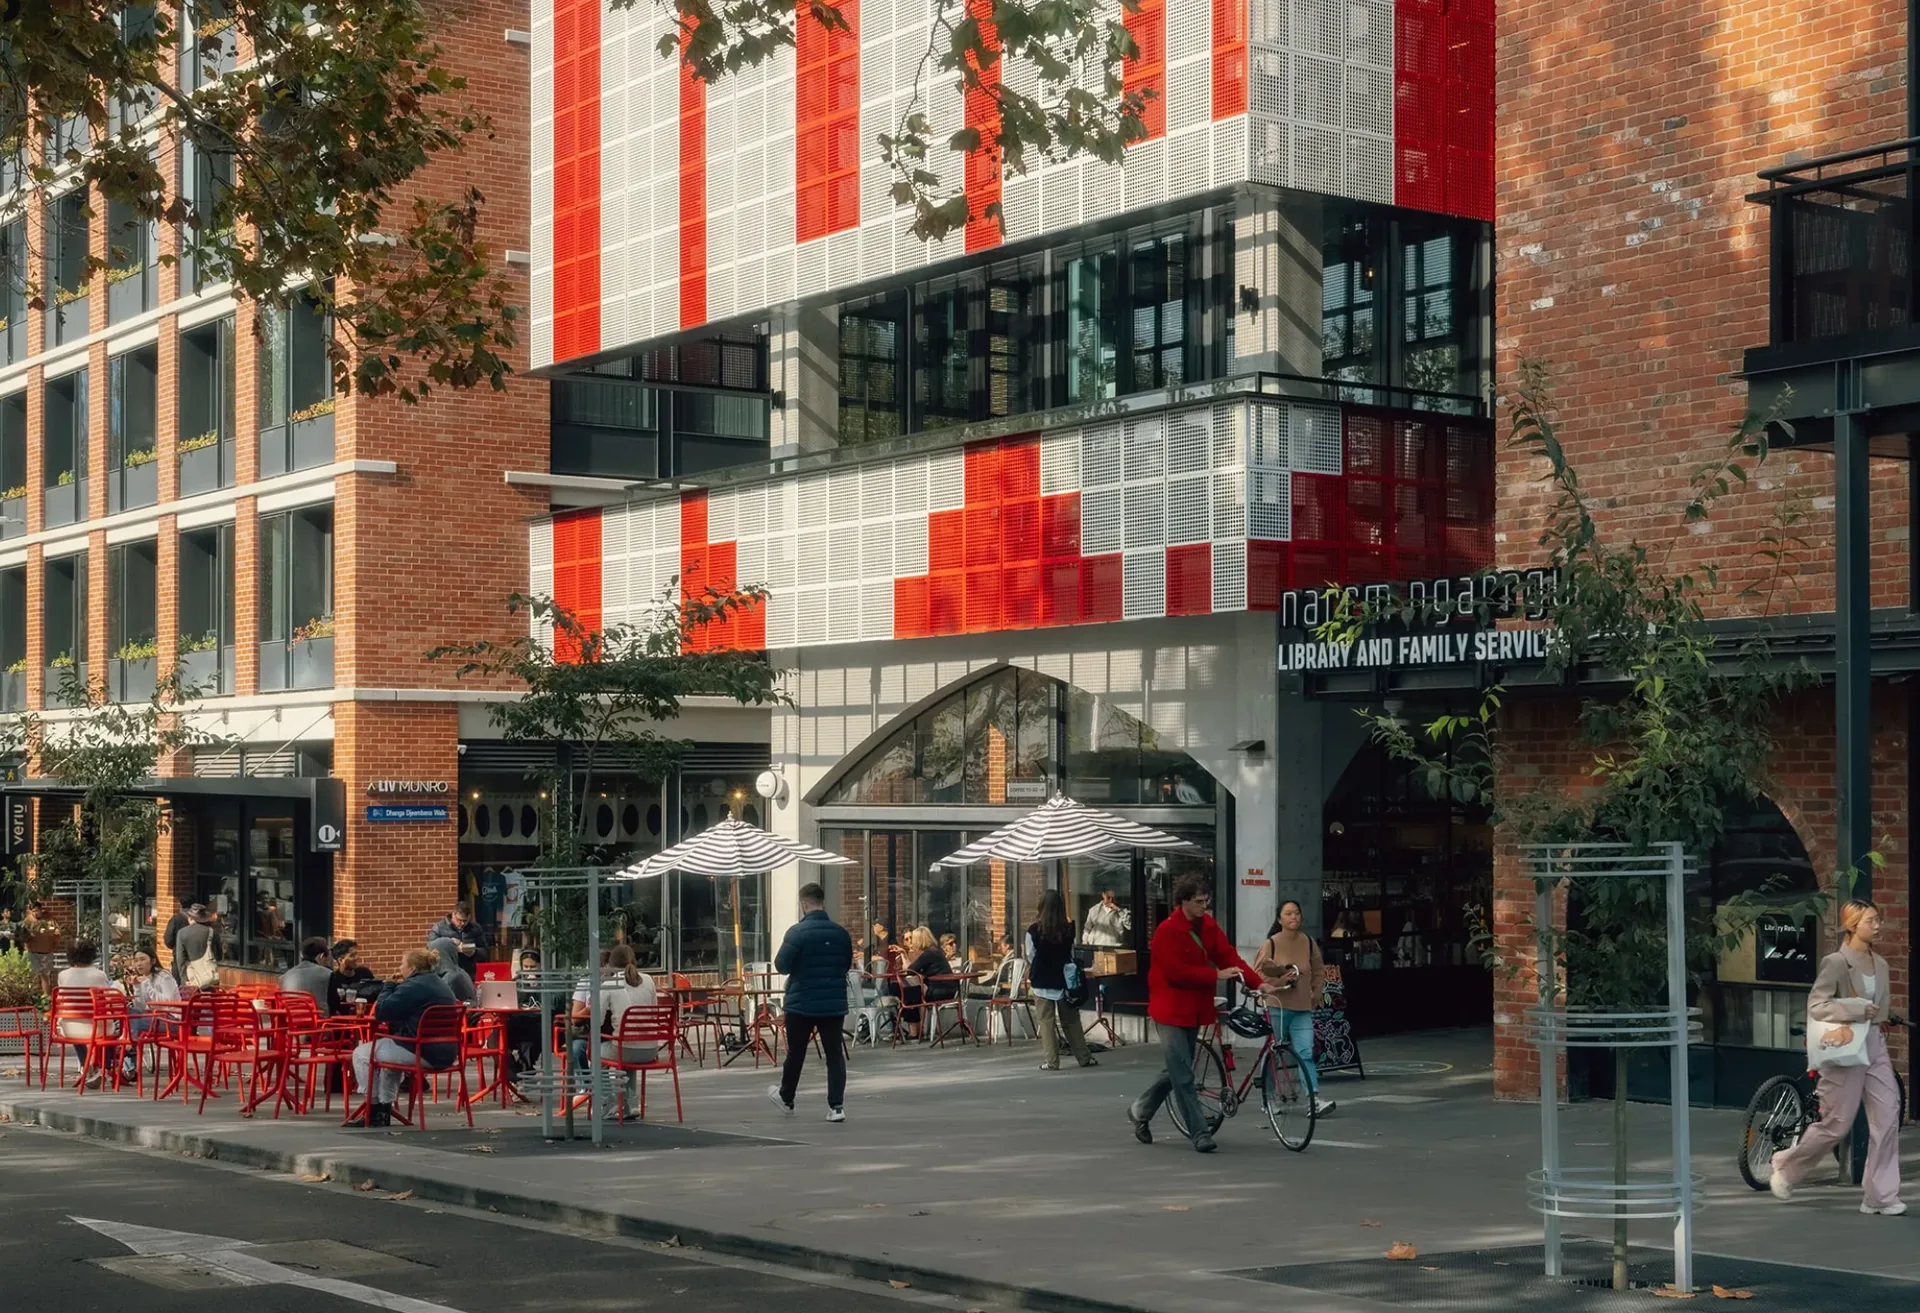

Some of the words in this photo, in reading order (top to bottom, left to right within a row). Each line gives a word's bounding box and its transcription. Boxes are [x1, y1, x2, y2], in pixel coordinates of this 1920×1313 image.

[1279, 641, 1350, 670] LIBRARY
[1357, 637, 1393, 667] AND
[1399, 632, 1469, 664] FAMILY
[378, 780, 395, 792] LIV
[399, 781, 449, 792] MUNRO
[13, 804, 27, 846] veriu
